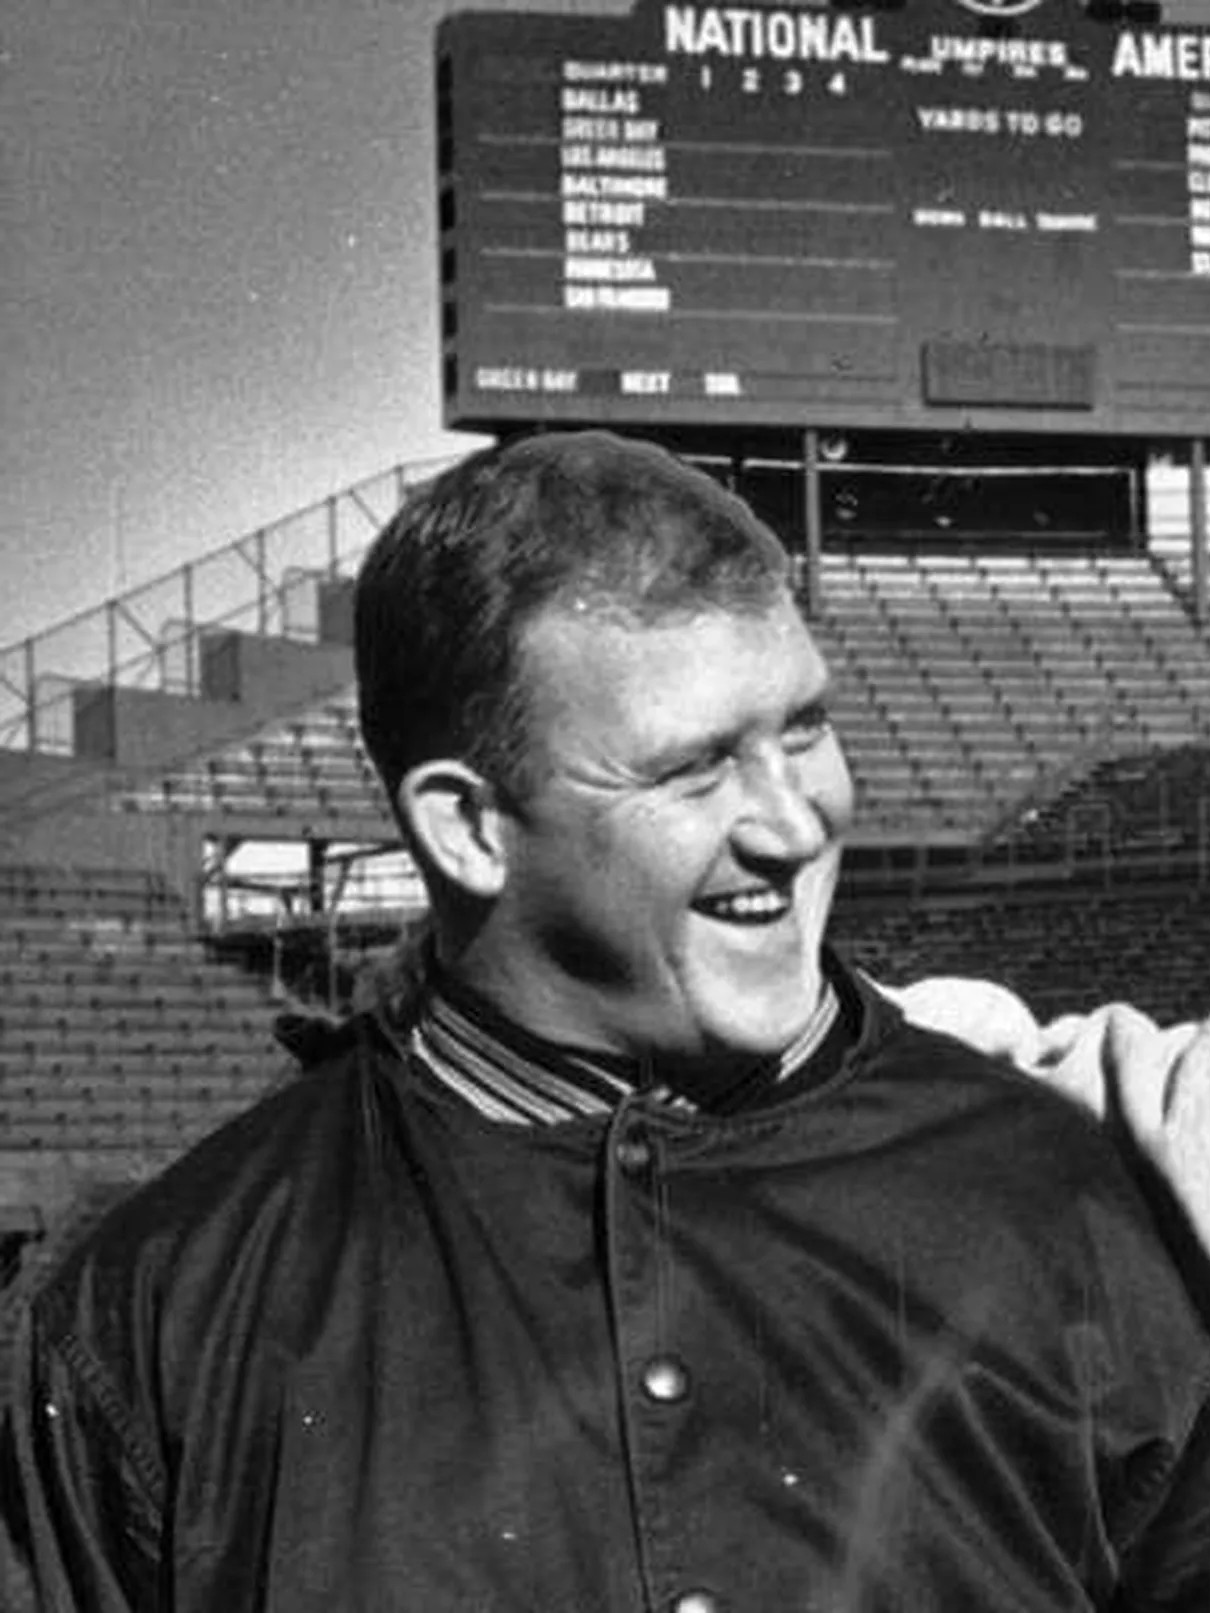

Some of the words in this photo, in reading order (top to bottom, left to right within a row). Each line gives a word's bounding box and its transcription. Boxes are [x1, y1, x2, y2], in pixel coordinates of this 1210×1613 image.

[664, 5, 890, 64] NATIONAL
[931, 35, 1067, 67] UMPIRES
[563, 61, 667, 84] QUARTER
[701, 65, 711, 91] 1
[742, 67, 760, 93] 2
[784, 69, 802, 95] 3
[827, 71, 846, 96] 4
[562, 86, 639, 113] DALLAS
[915, 107, 999, 134] YARDS
[1005, 111, 1039, 135] TO
[1044, 111, 1083, 137] GO
